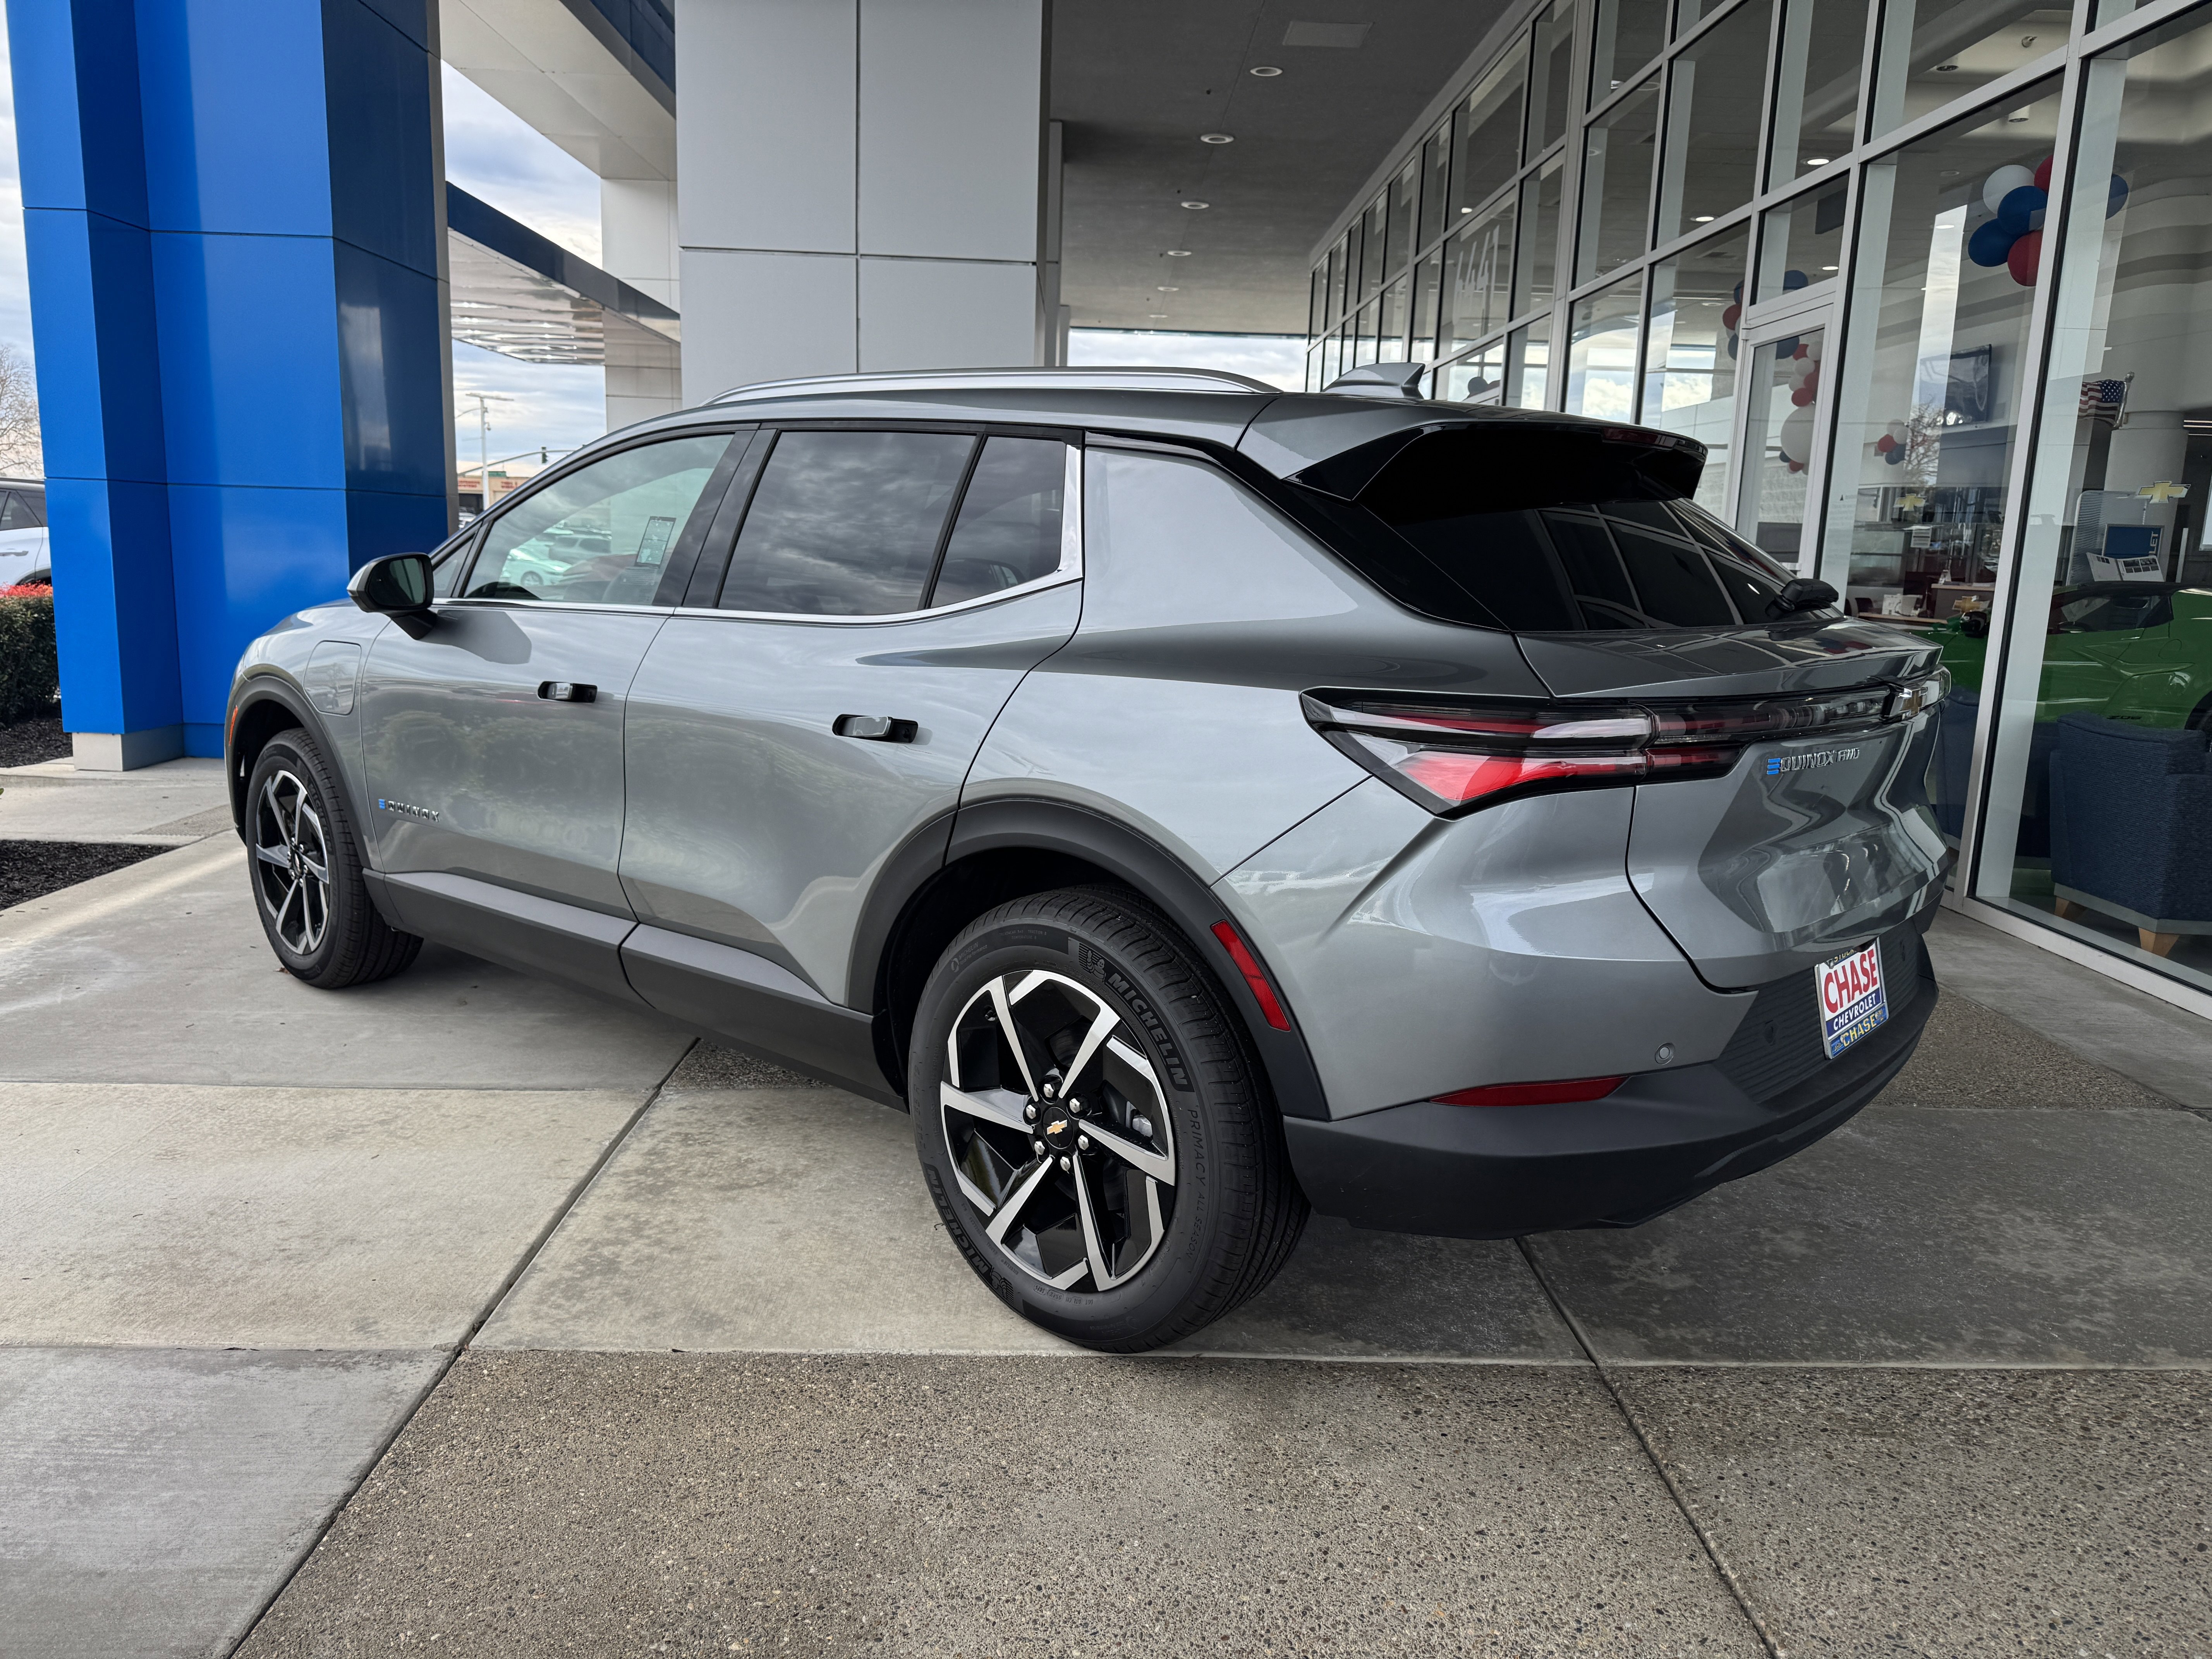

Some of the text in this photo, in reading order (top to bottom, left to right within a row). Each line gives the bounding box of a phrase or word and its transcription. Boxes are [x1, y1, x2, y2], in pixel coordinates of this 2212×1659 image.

[378, 799, 440, 822] EQUINOX
[1824, 948, 1878, 1013] CHASE
[1833, 993, 1875, 1030] CHEVROLET
[1108, 973, 1188, 1085] MICHELIN
[1842, 1013, 1877, 1047] CHASE
[1185, 1108, 1206, 1260] PRIMACY ALL SEASON
[927, 1168, 990, 1275] MICHELIN
